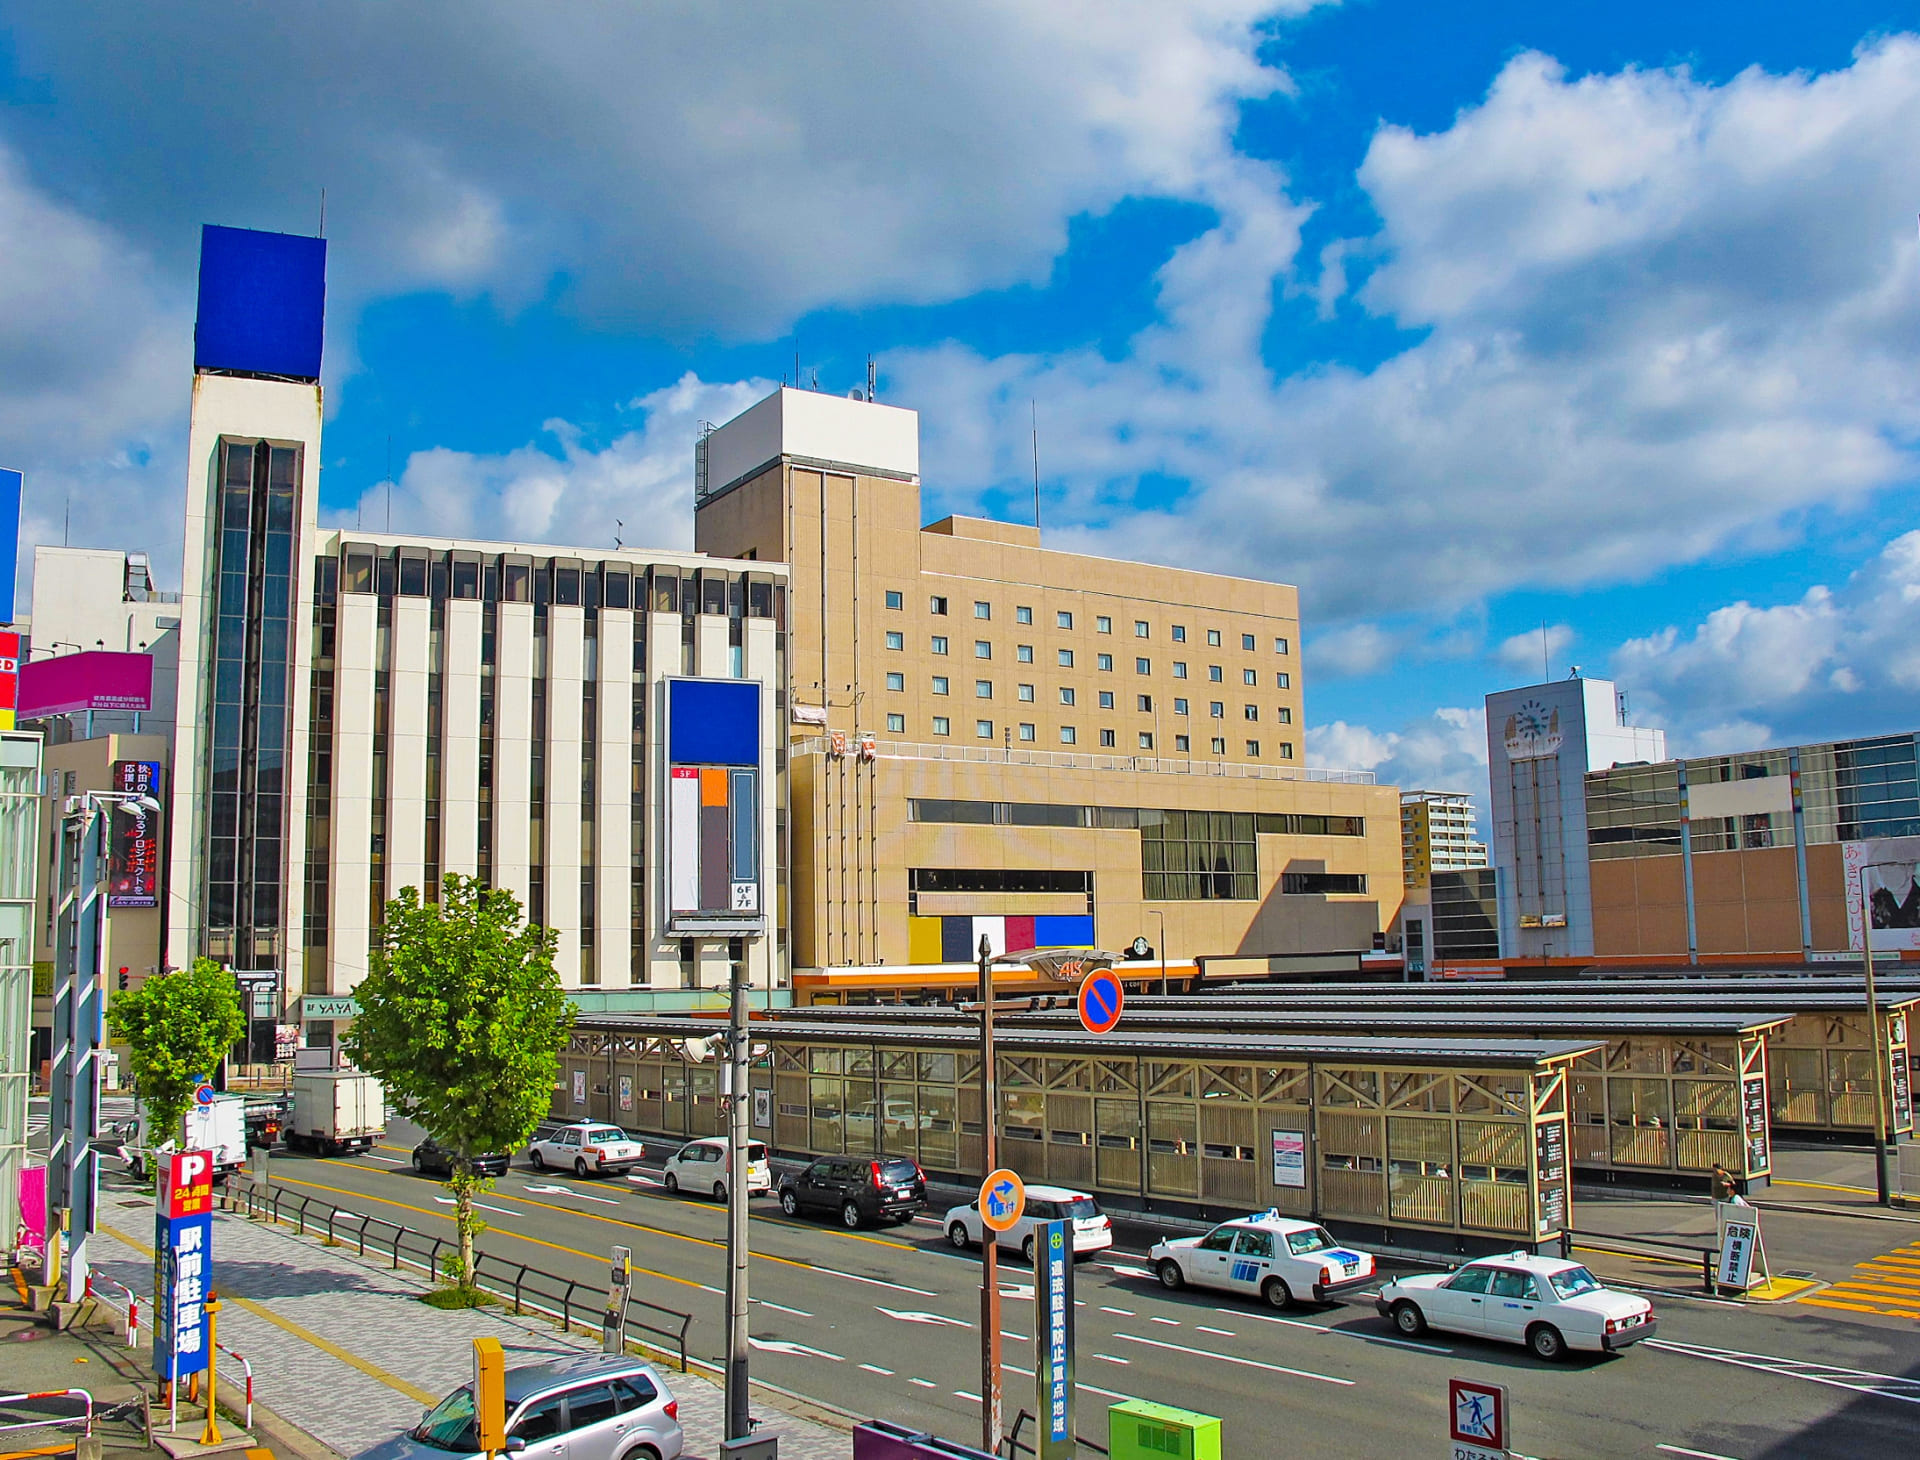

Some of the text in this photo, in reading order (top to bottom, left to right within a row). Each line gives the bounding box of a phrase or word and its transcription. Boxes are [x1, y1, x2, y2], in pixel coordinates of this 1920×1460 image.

[0, 660, 14, 670] D
[679, 770, 691, 778] 5F
[737, 885, 751, 893] 6F
[181, 1155, 206, 1186] P
[1727, 1225, 1751, 1240] 危険
[1726, 1240, 1742, 1283] 横断禁止
[178, 1225, 202, 1354] 駅前駐車場
[1051, 1260, 1065, 1433] 違法駐車防止重点地域
